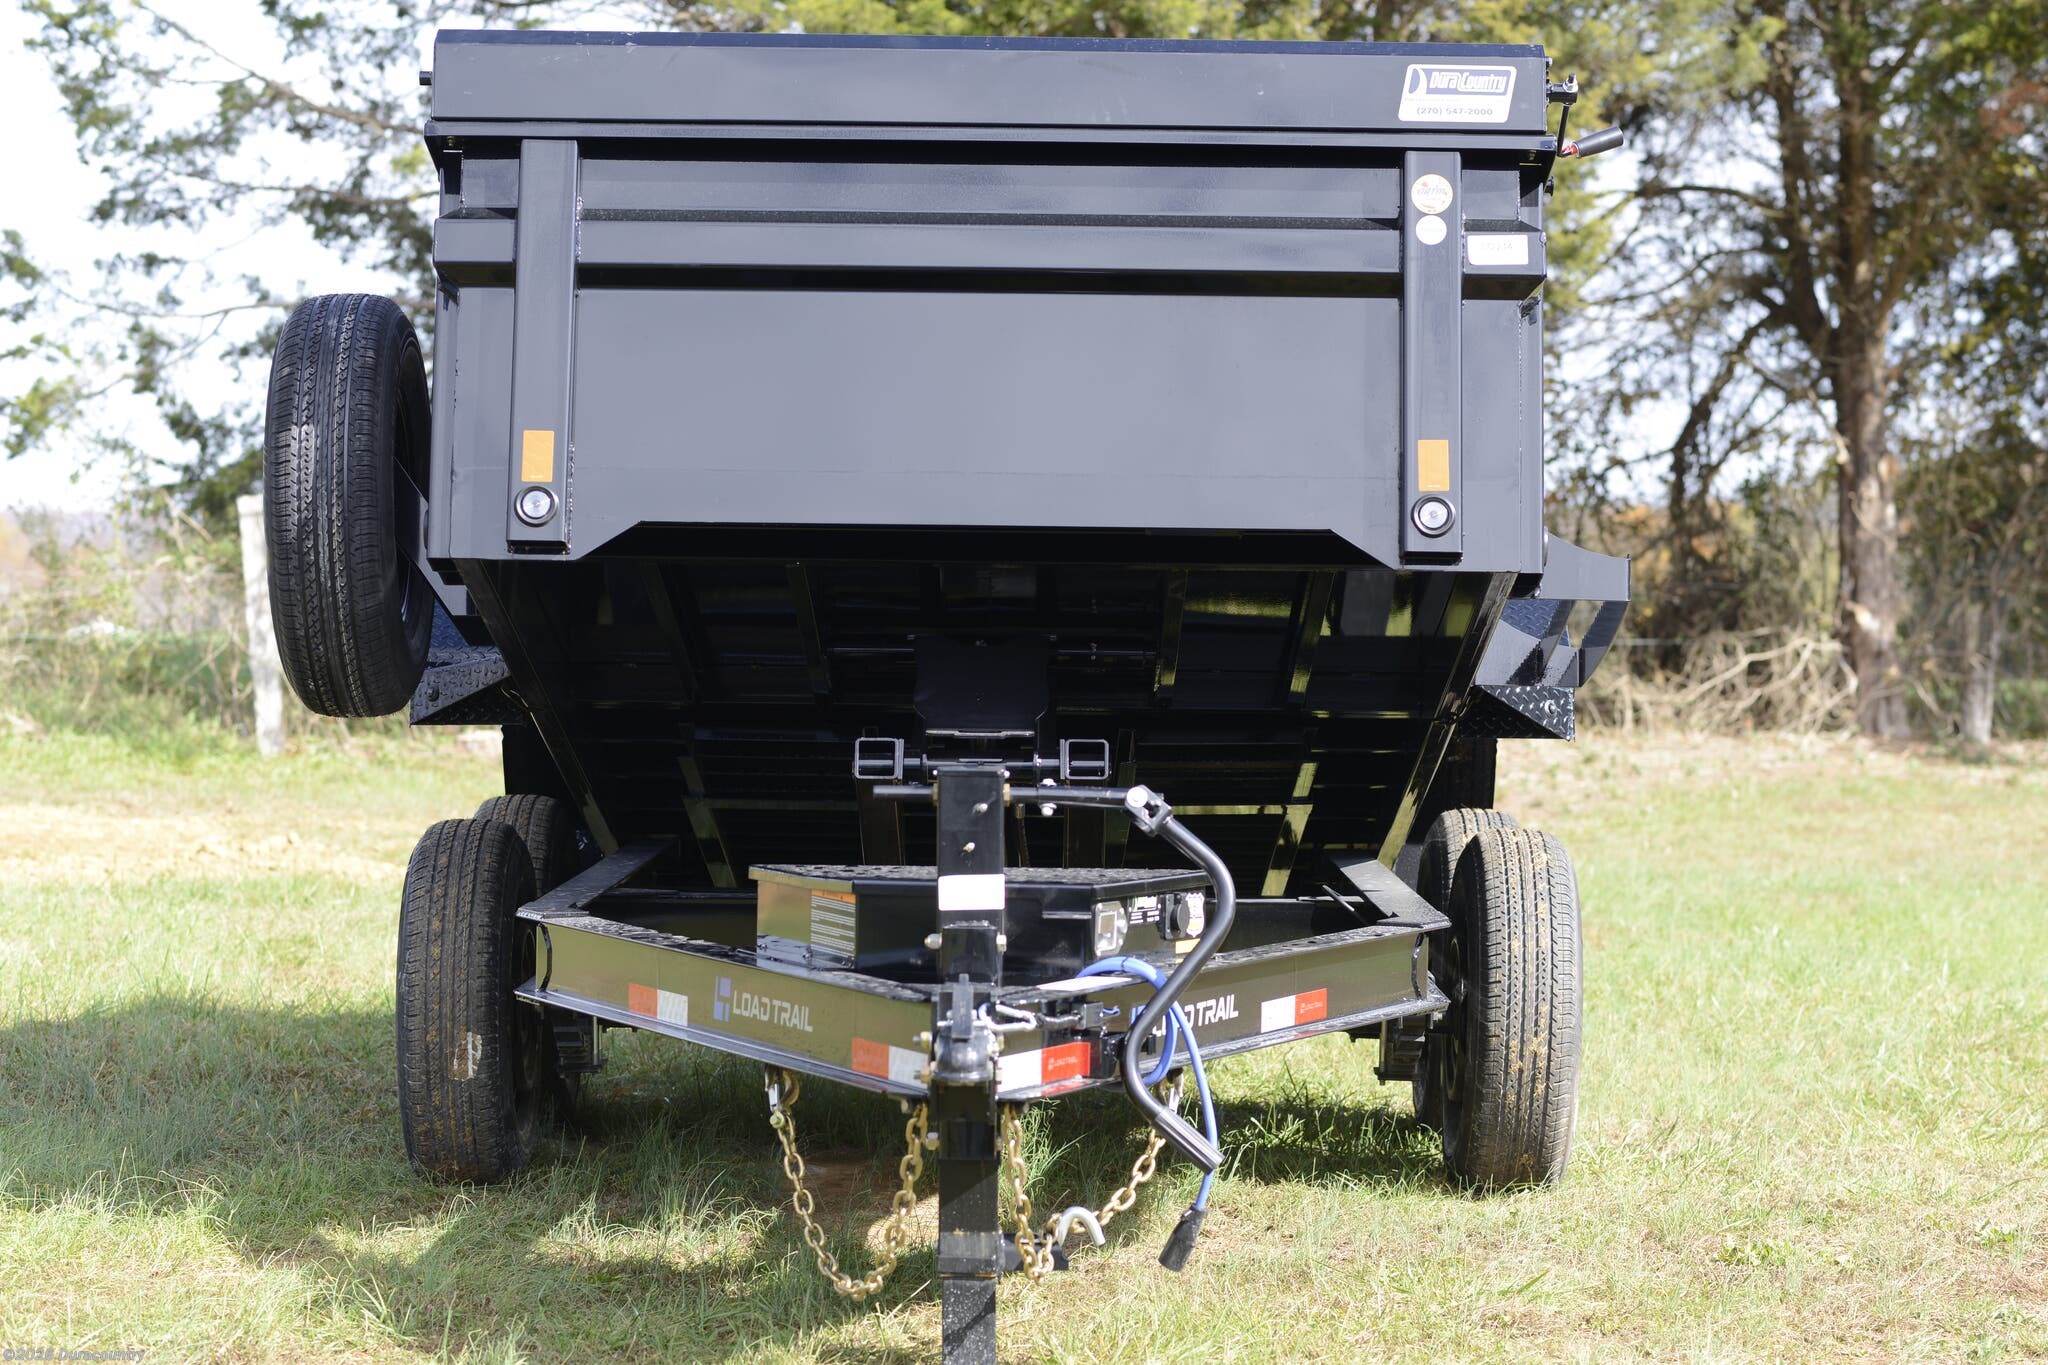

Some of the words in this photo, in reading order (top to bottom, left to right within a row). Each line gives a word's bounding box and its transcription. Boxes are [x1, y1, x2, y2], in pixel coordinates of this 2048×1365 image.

[1416, 107, 1442, 116] (270)
[1446, 108, 1493, 116] 547-2000
[1196, 994, 1239, 1027] TRAIL
